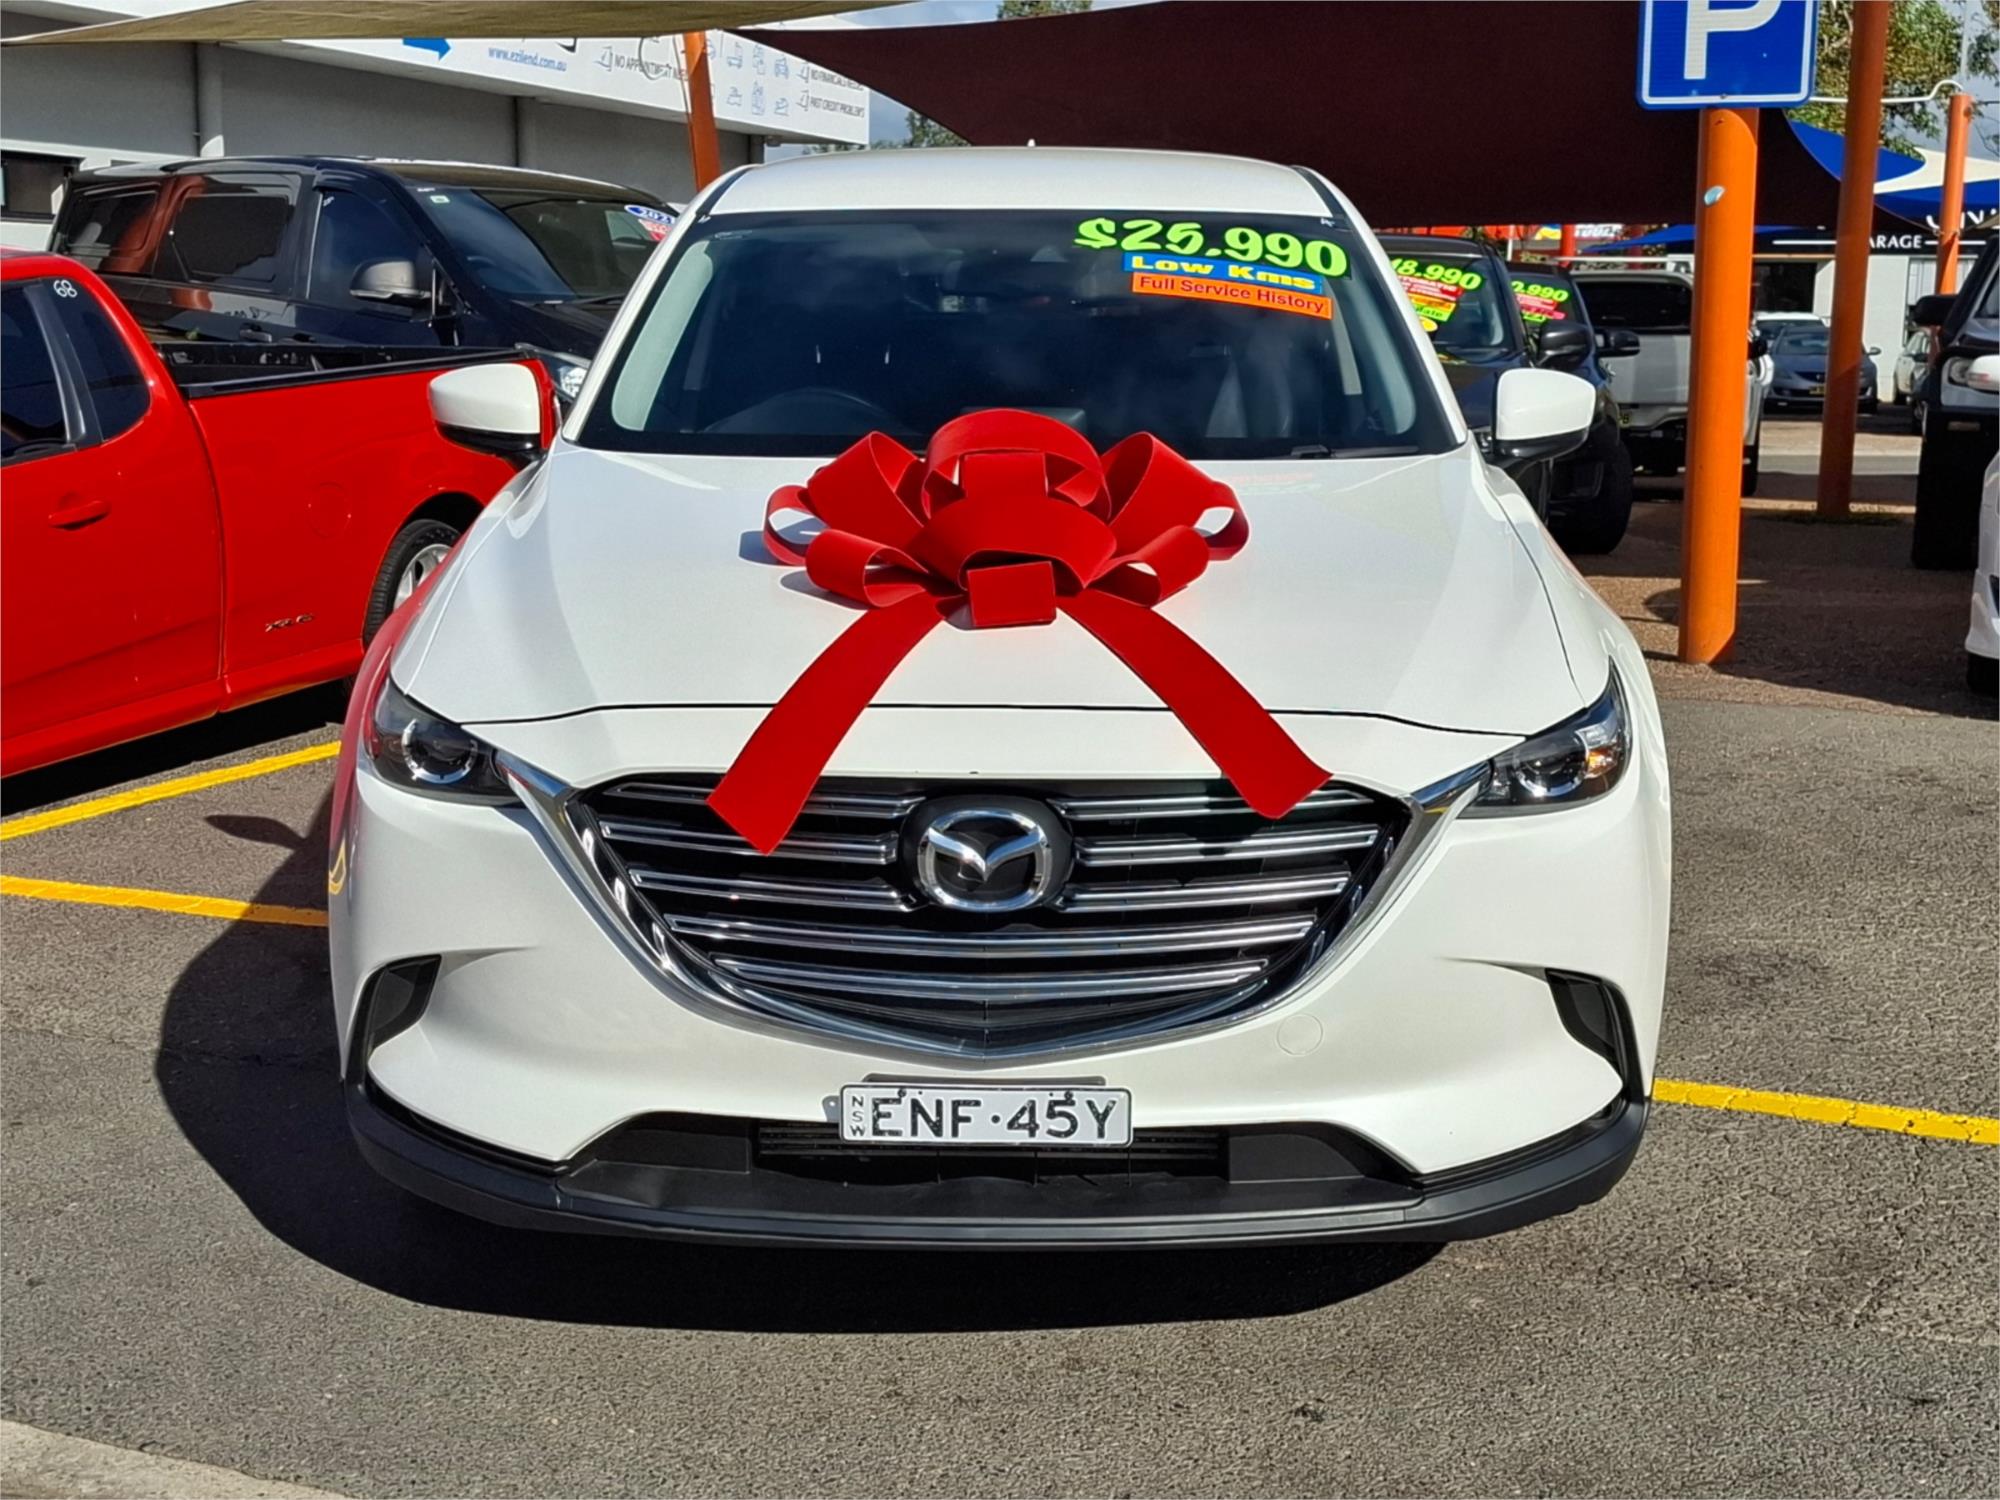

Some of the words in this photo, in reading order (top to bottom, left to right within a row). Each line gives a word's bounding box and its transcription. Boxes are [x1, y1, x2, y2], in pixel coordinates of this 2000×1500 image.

[487, 47, 567, 72] www.ezilend.com.au
[615, 54, 625, 68] NO
[1132, 256, 1214, 276] Low
[1228, 264, 1316, 291] Kms
[53, 280, 78, 298] 68
[1140, 276, 1175, 291] Full
[1181, 280, 1250, 299] Service
[1257, 289, 1324, 313] History
